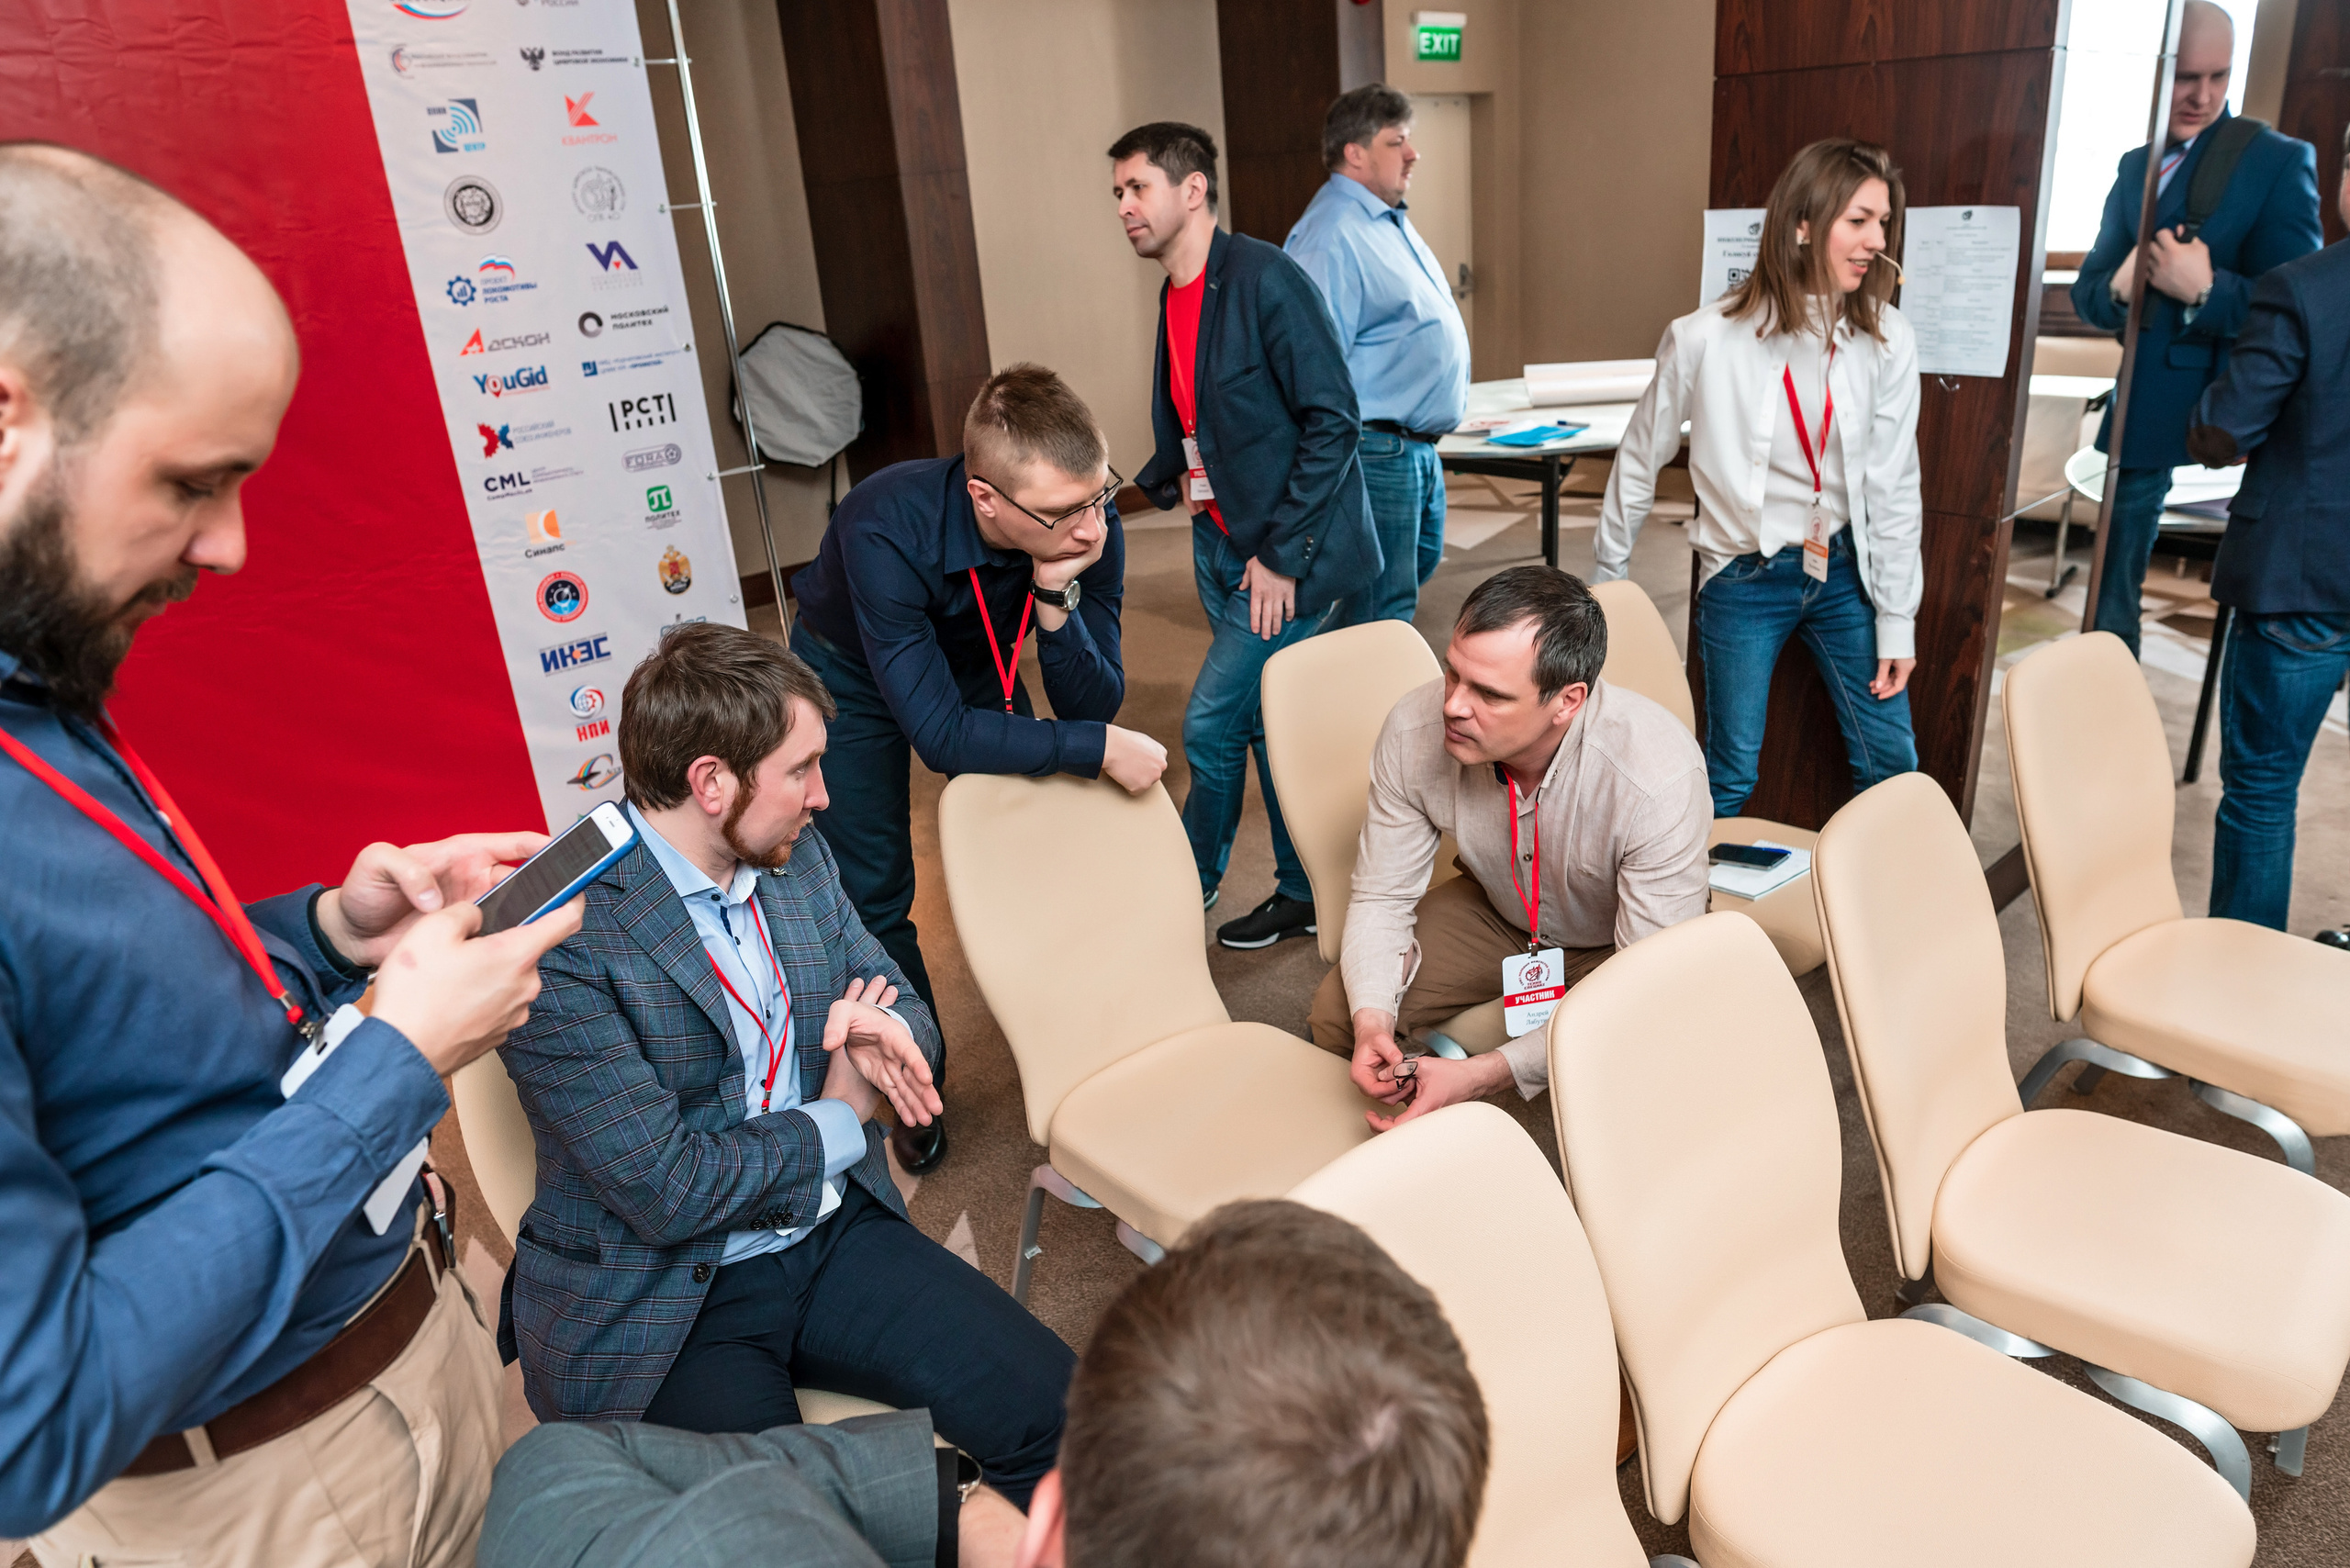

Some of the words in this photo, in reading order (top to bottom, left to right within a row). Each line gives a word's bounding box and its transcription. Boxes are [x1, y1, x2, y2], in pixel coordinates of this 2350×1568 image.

[1419, 32, 1460, 54] EXIT
[561, 133, 618, 146] КВАНТРОН
[482, 282, 538, 295] ЛОКОМОТИВЫ
[484, 295, 509, 304] РОСТА
[610, 305, 669, 320] МОСКОВСКИЙ
[611, 319, 653, 330] ПОЛИТЕХ
[473, 364, 549, 398] YouGid
[484, 471, 531, 492] CML
[644, 510, 681, 523] ПОЛИТЕХ
[524, 543, 565, 559] Синапс
[576, 718, 610, 743] НПИ
[1515, 990, 1555, 1004] УЧАСТНИК
[1527, 1010, 1550, 1018] Андрей
